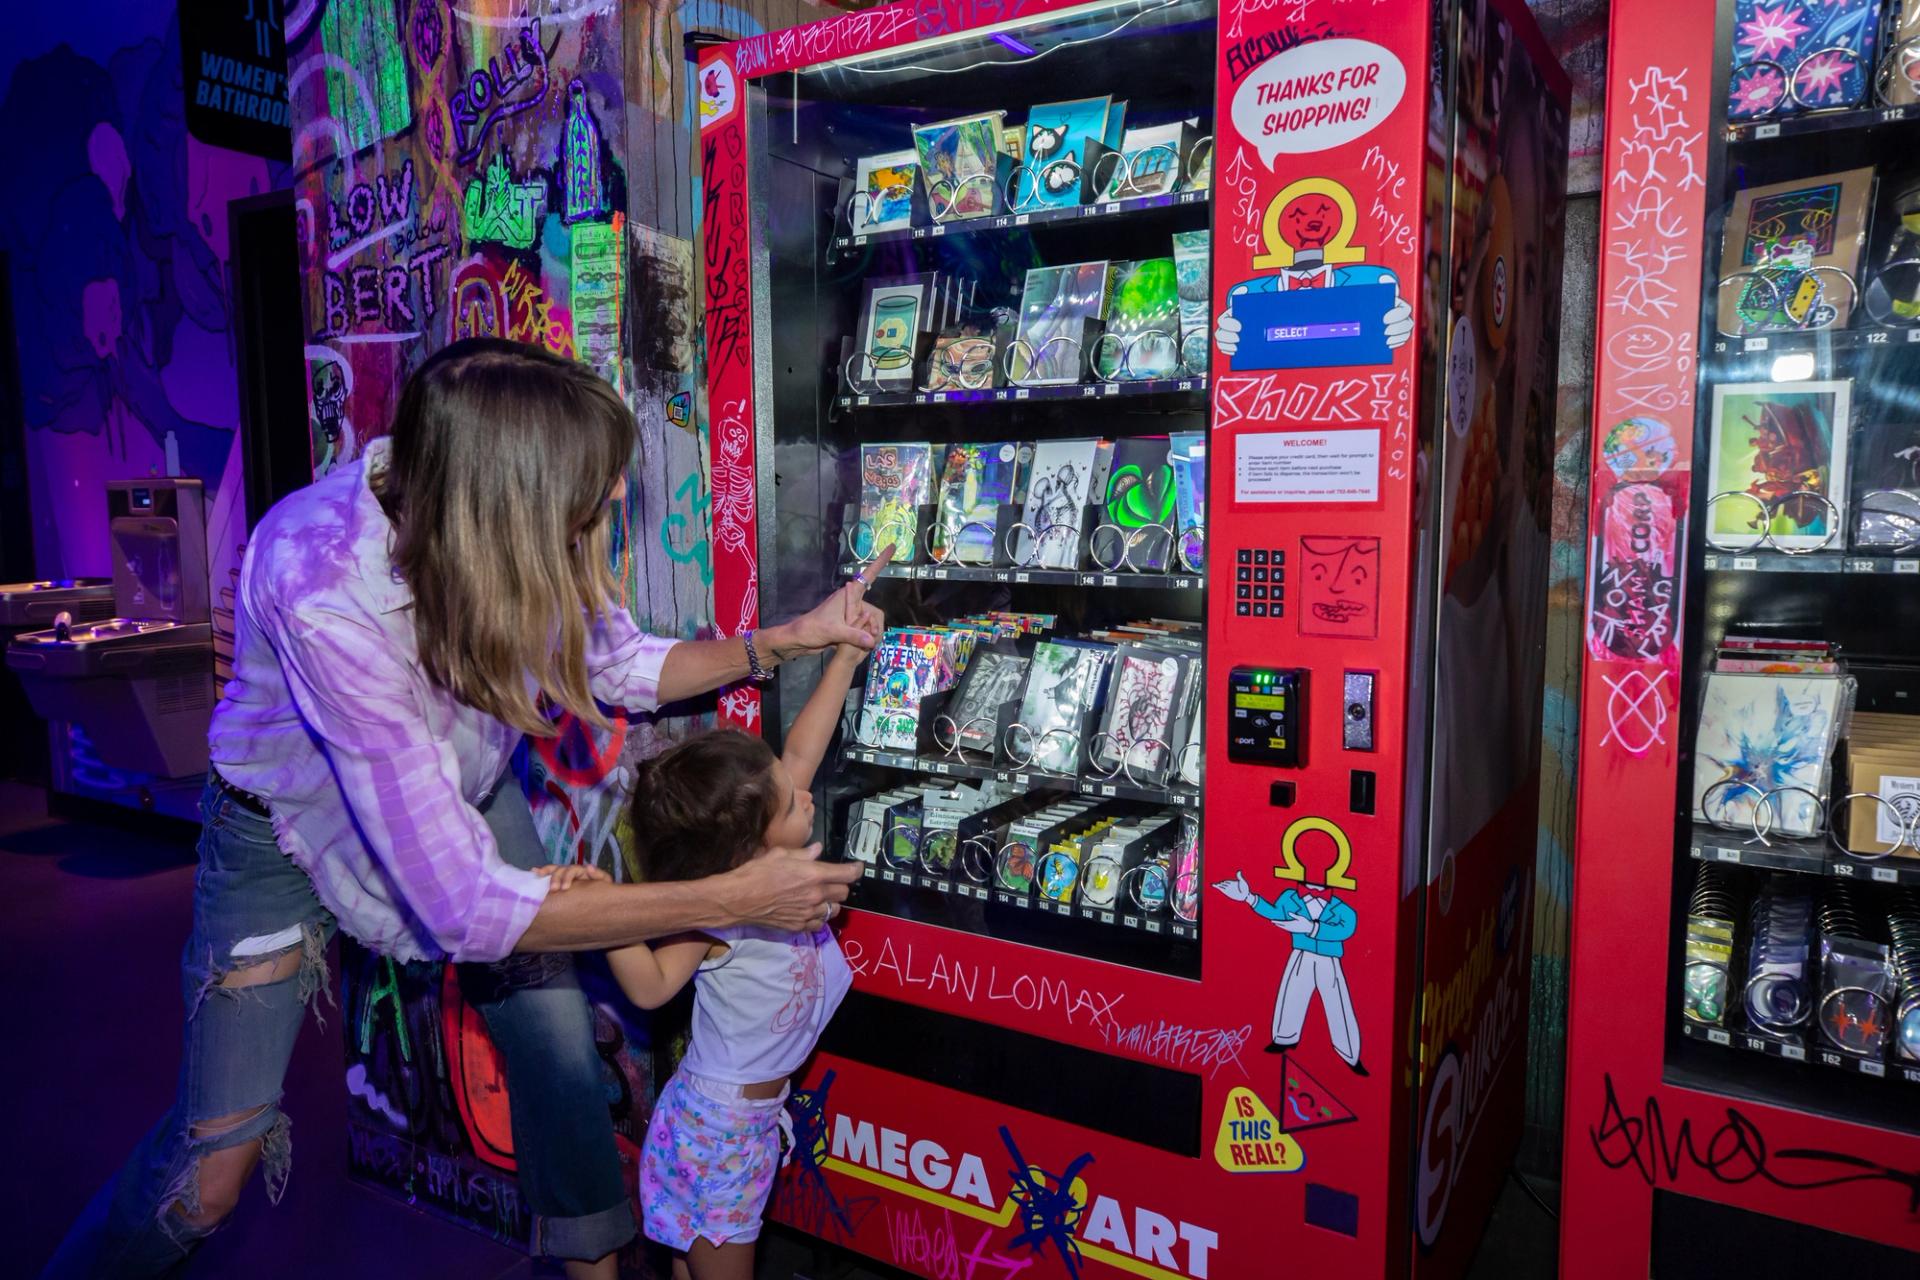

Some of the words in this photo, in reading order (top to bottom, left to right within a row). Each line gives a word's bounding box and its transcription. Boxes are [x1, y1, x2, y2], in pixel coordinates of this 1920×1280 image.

[1257, 73, 1333, 105] THANKS
[1337, 63, 1380, 91] FOR
[1262, 98, 1371, 136] SHOPPING!
[1882, 108, 1905, 120] 112
[1181, 193, 1194, 202] 118
[327, 159, 413, 249] LOW
[1084, 207, 1096, 215] 116
[915, 229, 925, 237] 112
[317, 244, 448, 341] BERT
[1274, 327, 1308, 338] SELECT
[1866, 333, 1888, 344] 122
[996, 391, 1007, 399] 124
[1283, 439, 1327, 447] WELCOME!
[865, 453, 896, 469] LAS
[1854, 561, 1874, 571] 132
[998, 773, 1008, 781] 154
[1082, 784, 1093, 792] 156
[1173, 796, 1185, 804] 158
[1833, 864, 1854, 876] 152
[999, 895, 1008, 903] 164
[872, 937, 979, 1002] ALAN
[988, 966, 1125, 1026] LOMAX
[1747, 1038, 1765, 1050] 161
[1822, 1053, 1841, 1066] 162
[1235, 1096, 1255, 1118] IS
[1229, 1120, 1272, 1141] THIS
[1230, 1142, 1287, 1166] REAL?
